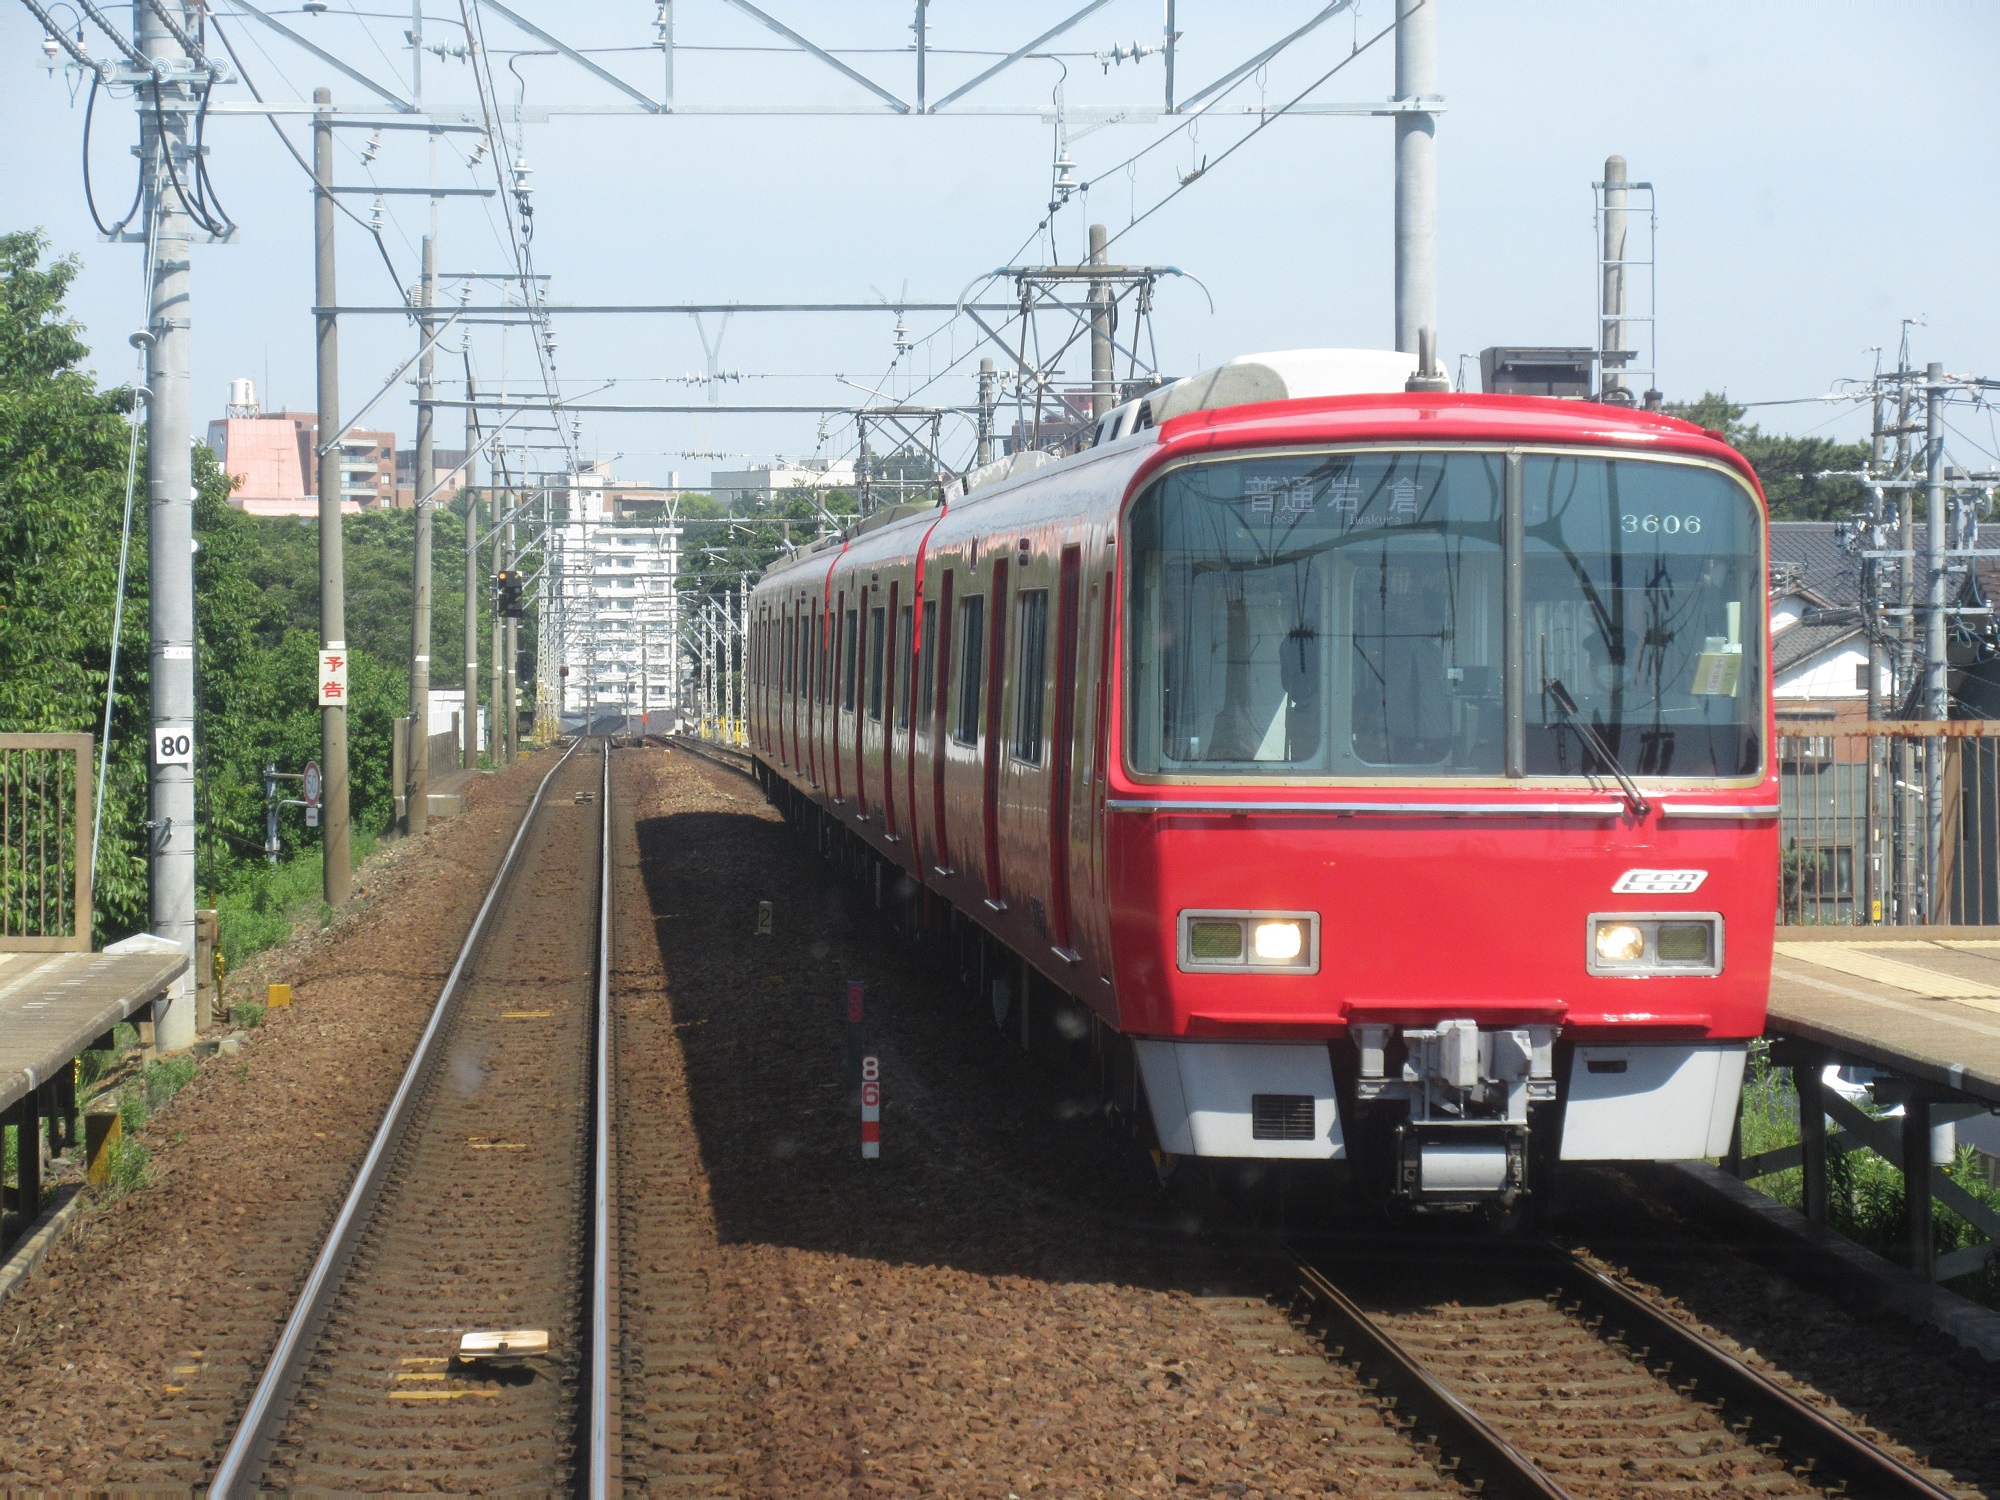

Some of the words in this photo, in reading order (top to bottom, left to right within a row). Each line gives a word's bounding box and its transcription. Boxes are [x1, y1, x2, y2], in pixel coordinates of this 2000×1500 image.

[1263, 514, 1298, 525] Local
[1621, 514, 1701, 534] 3606
[322, 656, 345, 698] 予告
[160, 734, 190, 757] 80
[759, 908, 772, 928] 2
